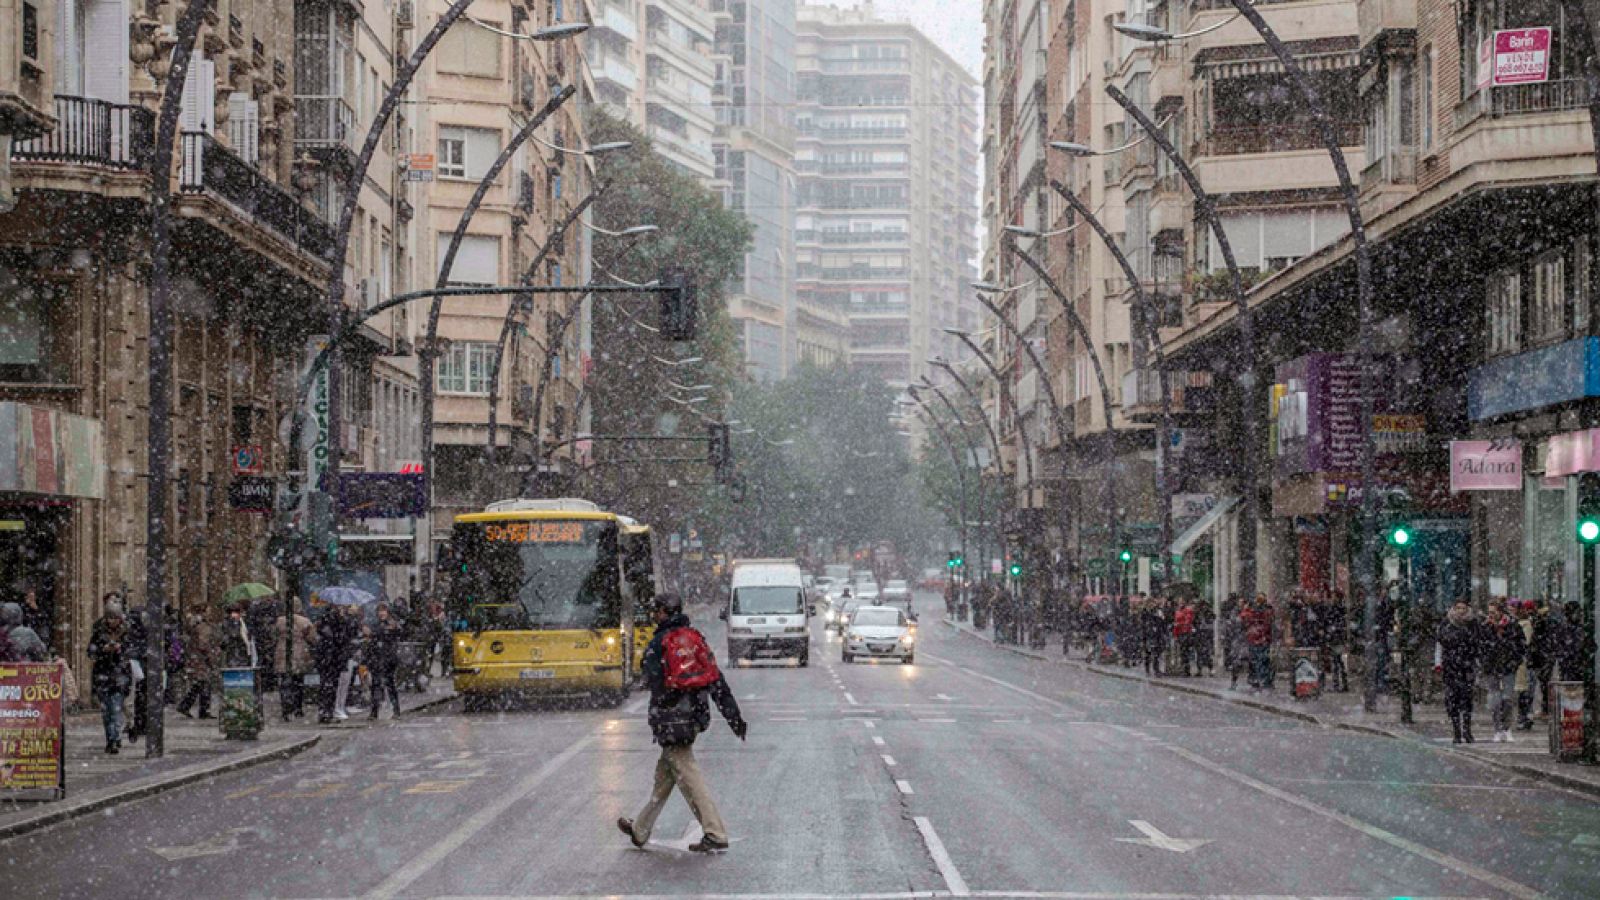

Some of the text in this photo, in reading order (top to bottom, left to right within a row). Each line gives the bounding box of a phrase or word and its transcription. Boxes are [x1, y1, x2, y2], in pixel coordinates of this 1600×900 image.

[1506, 53, 1534, 63] VENDE
[1459, 454, 1516, 474] Adara
[23, 682, 61, 701] ORO
